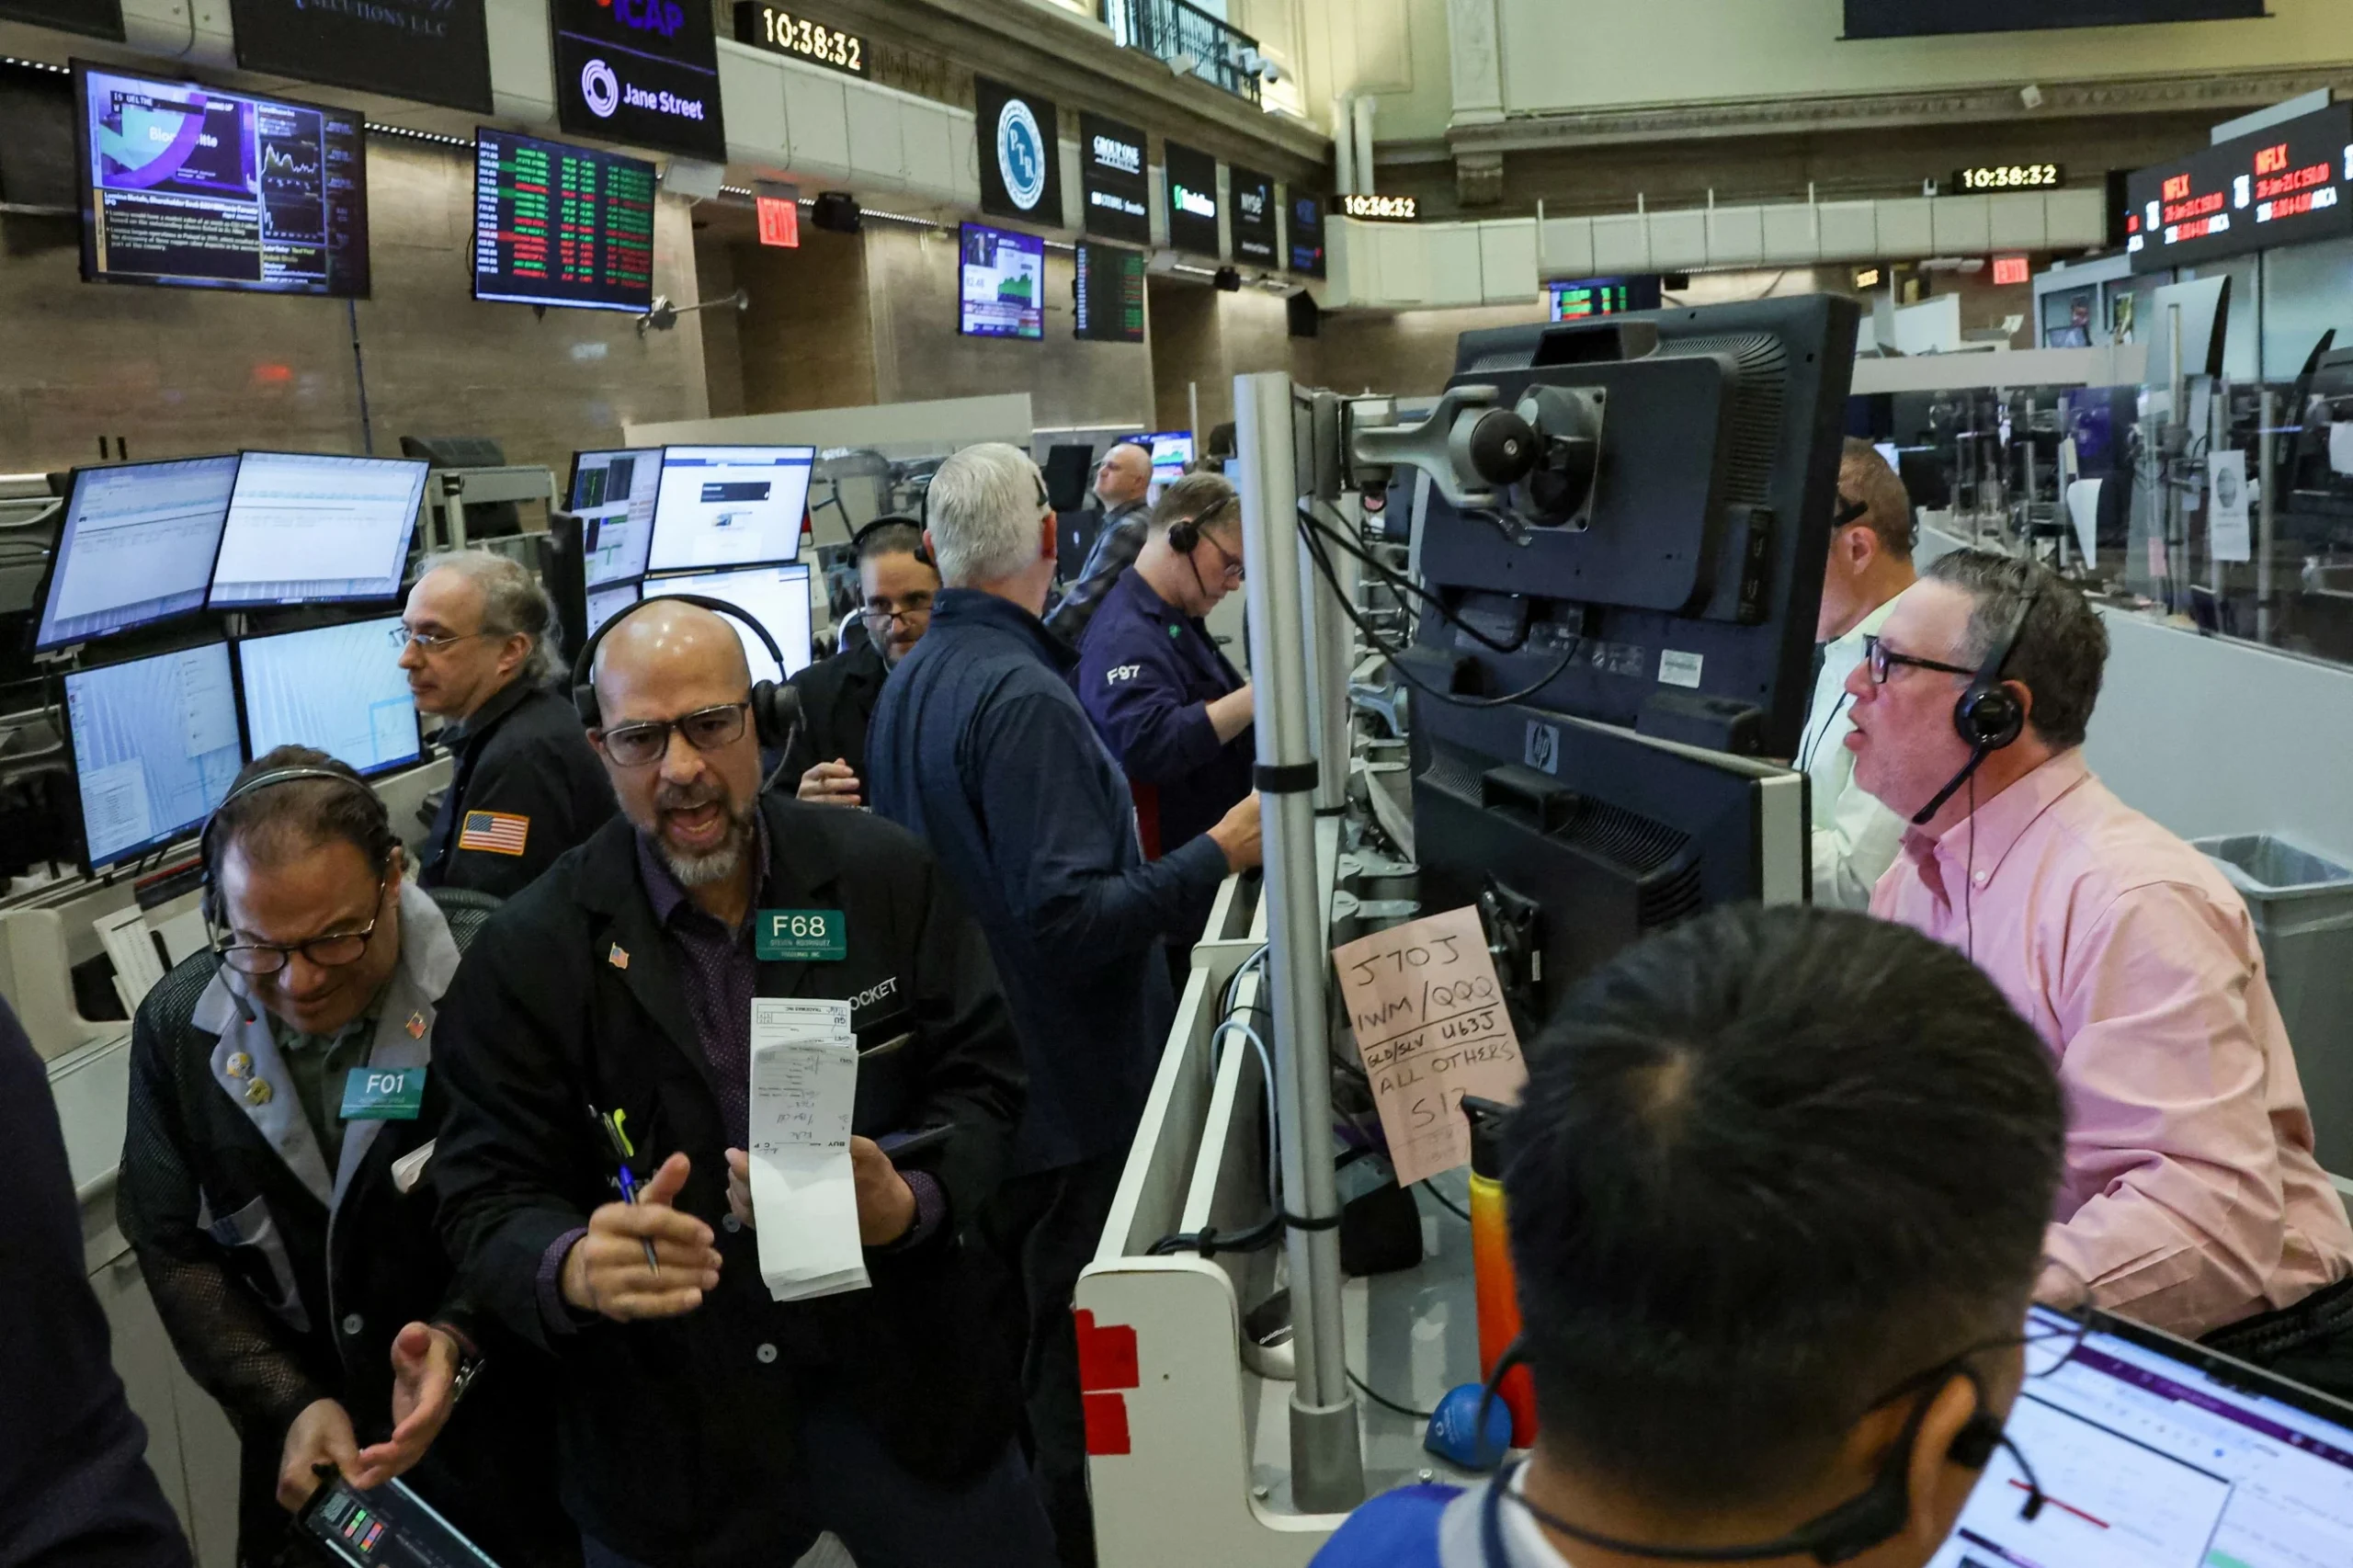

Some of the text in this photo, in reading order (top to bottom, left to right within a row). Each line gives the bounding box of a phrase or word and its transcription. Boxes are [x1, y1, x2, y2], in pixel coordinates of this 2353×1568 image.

[614, 0, 684, 37] ICAP
[763, 8, 861, 71] 10:38:32
[623, 83, 704, 120] Jane Street
[2256, 142, 2287, 176] NFLX
[1963, 165, 2057, 188] 10:38:32
[1345, 195, 1415, 218] 10:38:32
[1107, 665, 1141, 686] F97
[773, 915, 826, 937] F68
[848, 976, 897, 1011] OCKET
[366, 1074, 404, 1094] F01
[1380, 1040, 1516, 1096] ALL OTHERS
